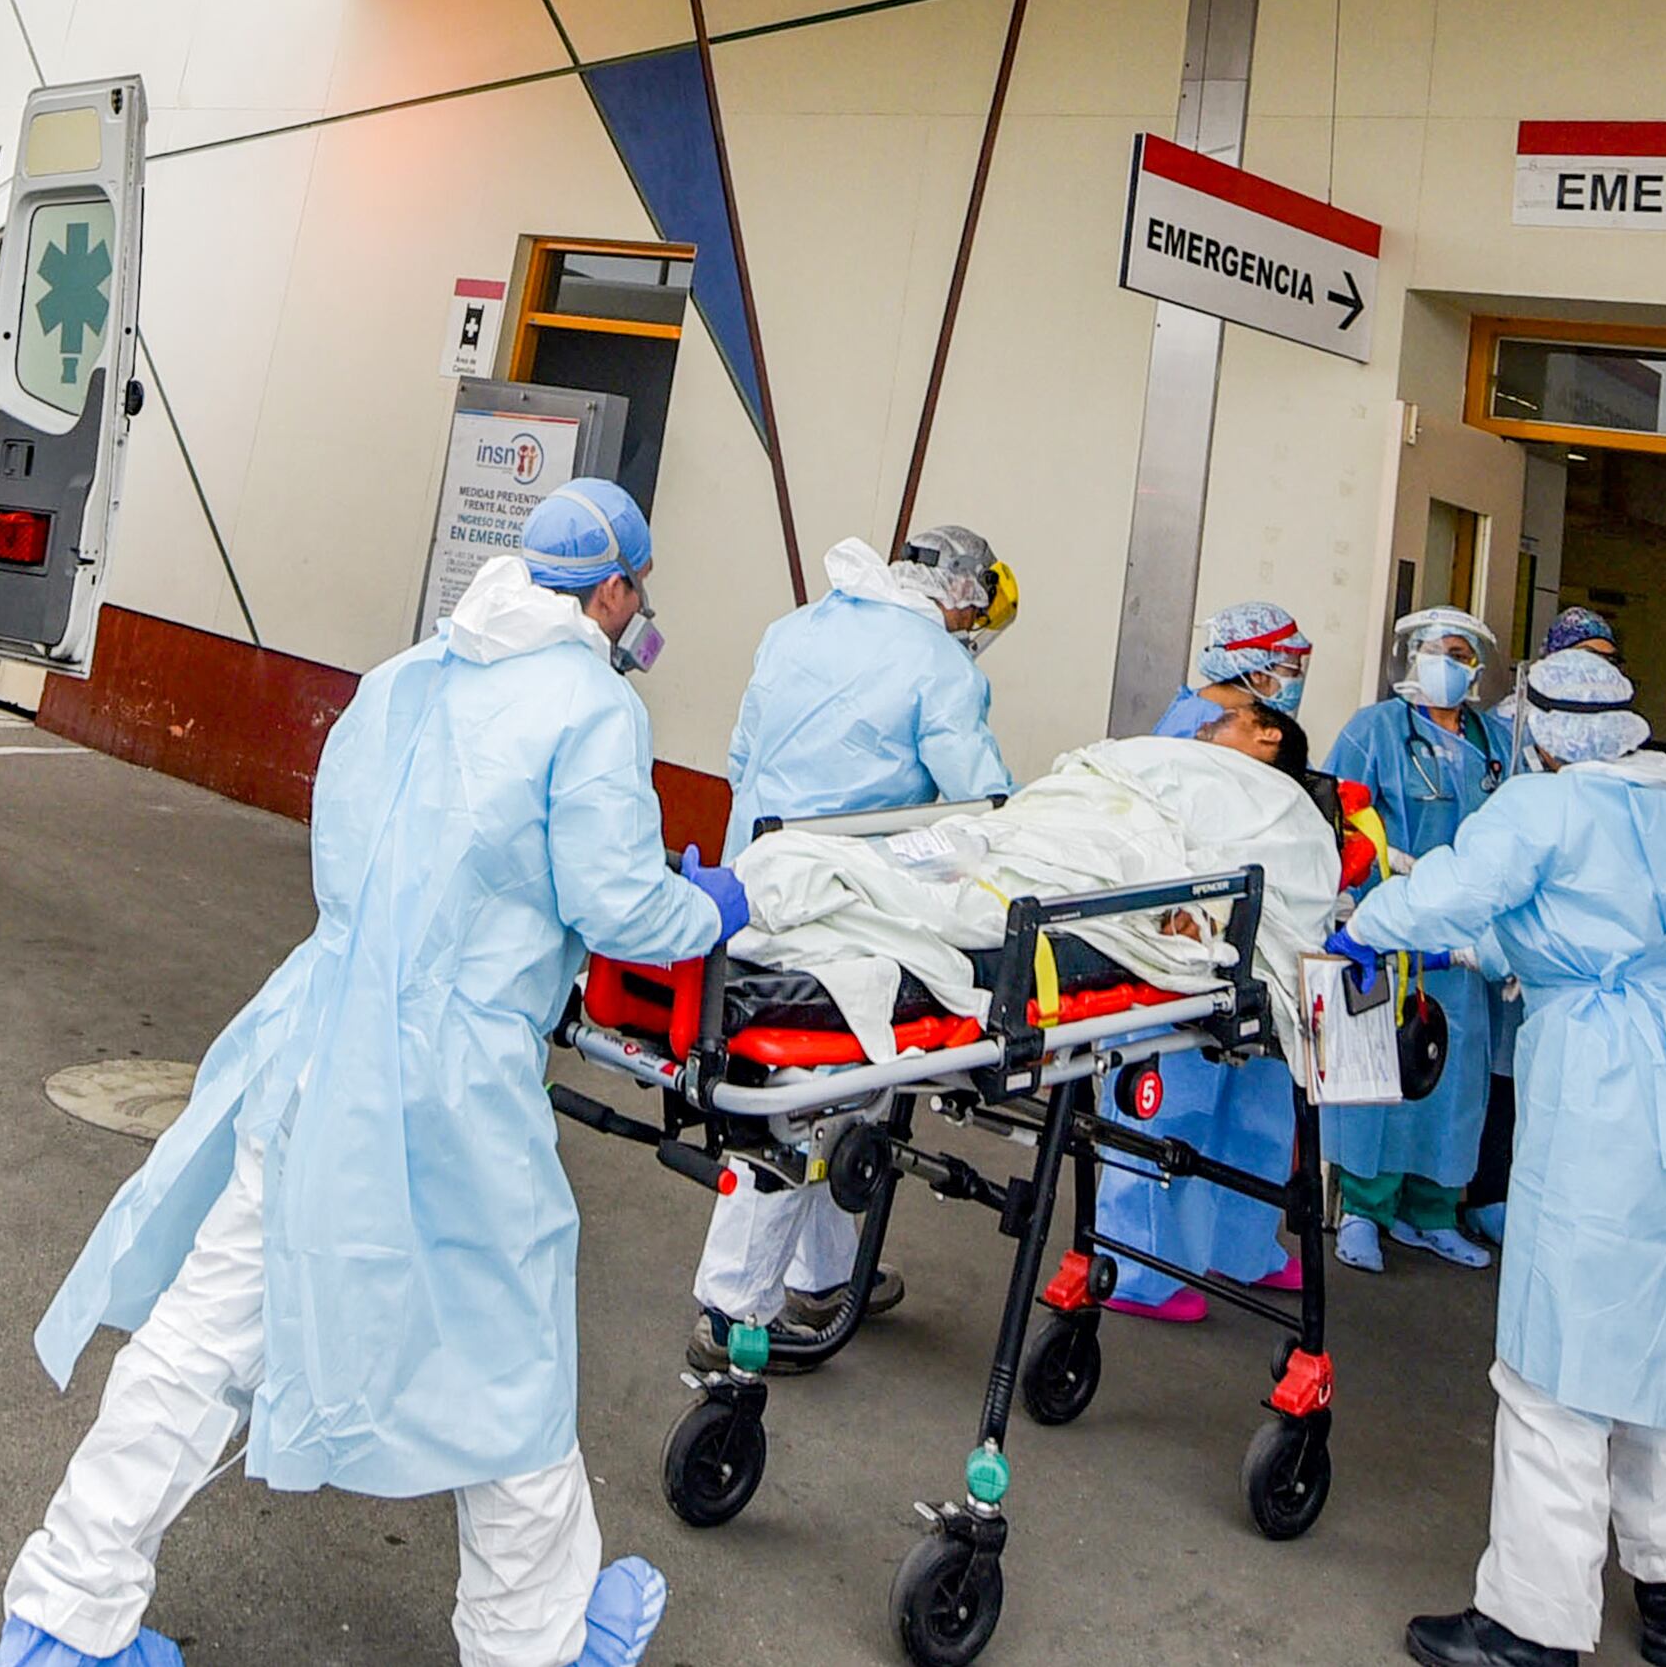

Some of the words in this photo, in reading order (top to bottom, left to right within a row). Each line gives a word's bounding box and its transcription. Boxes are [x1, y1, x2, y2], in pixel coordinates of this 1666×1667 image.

[1146, 217, 1315, 304] EMERGENCIA
[476, 438, 515, 466] insn
[464, 498, 495, 513] FRENTE
[497, 503, 507, 514] AL
[458, 514, 493, 528] INGRESO
[494, 518, 505, 529] DE
[450, 525, 466, 541] EN
[1142, 1079, 1155, 1110] 5
